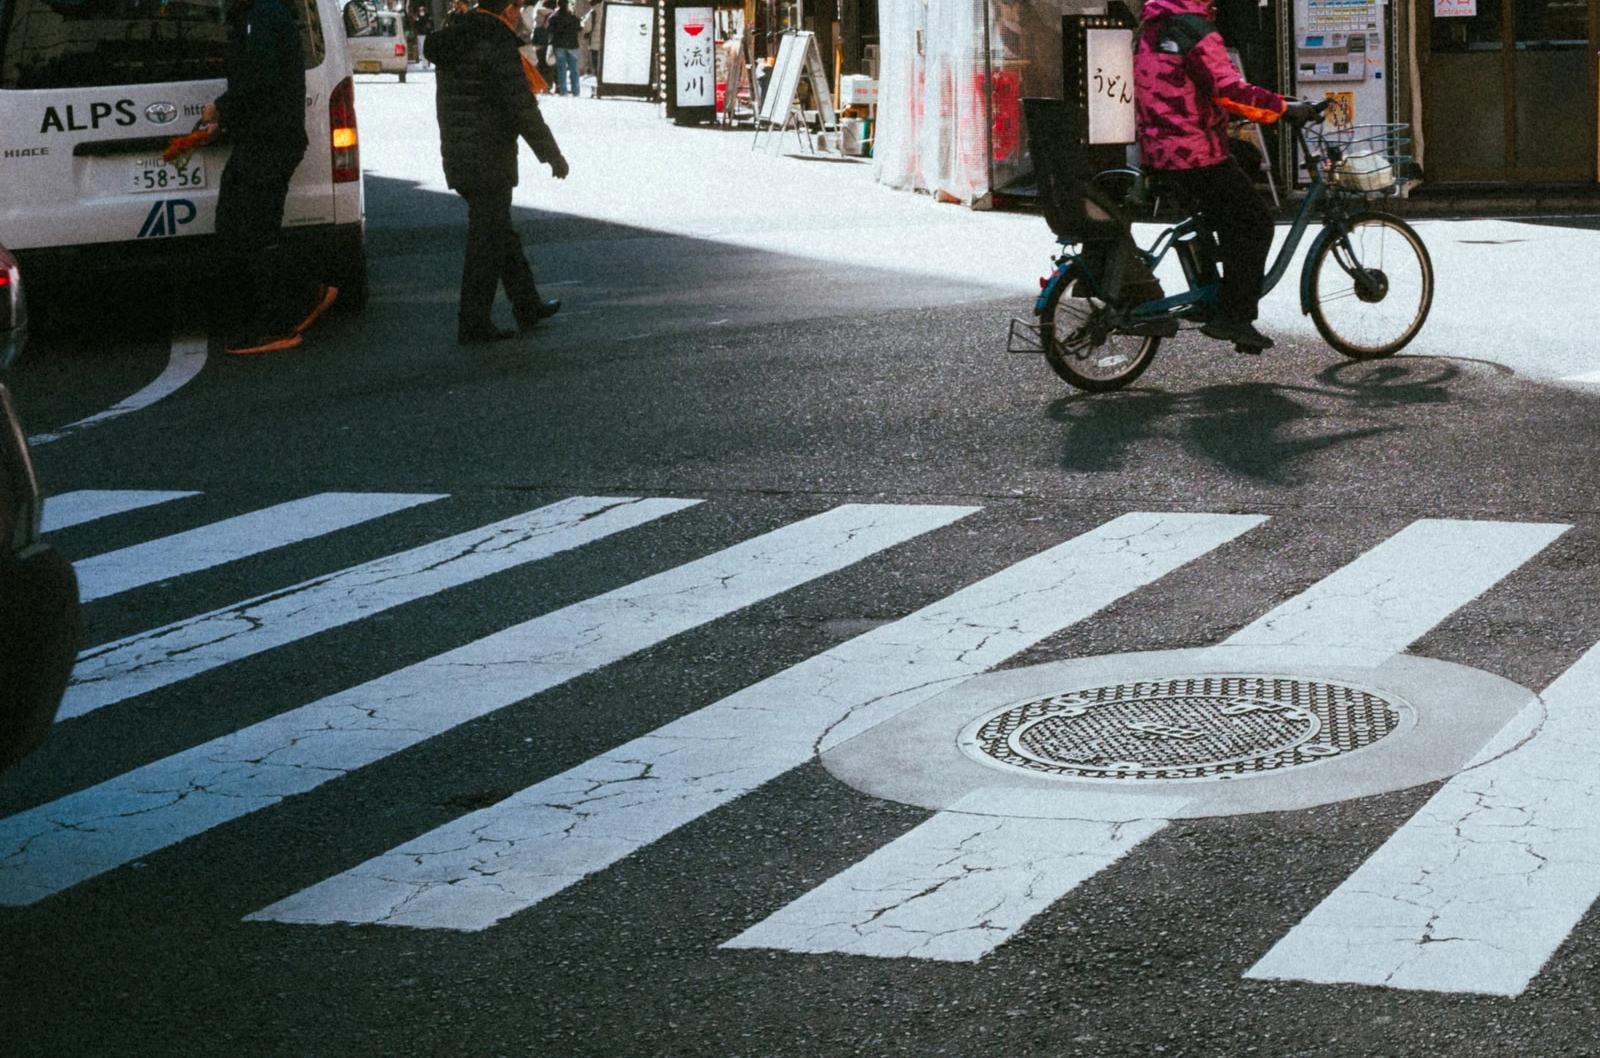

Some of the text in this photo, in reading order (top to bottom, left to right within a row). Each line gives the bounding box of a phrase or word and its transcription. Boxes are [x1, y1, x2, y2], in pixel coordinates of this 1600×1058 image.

[1438, 7, 1472, 15] Entrance
[683, 46, 707, 97] 流川
[1093, 67, 1133, 104] うどん
[40, 98, 137, 134] ALPS
[4, 146, 50, 159] HIACE
[143, 167, 202, 189] 58-56
